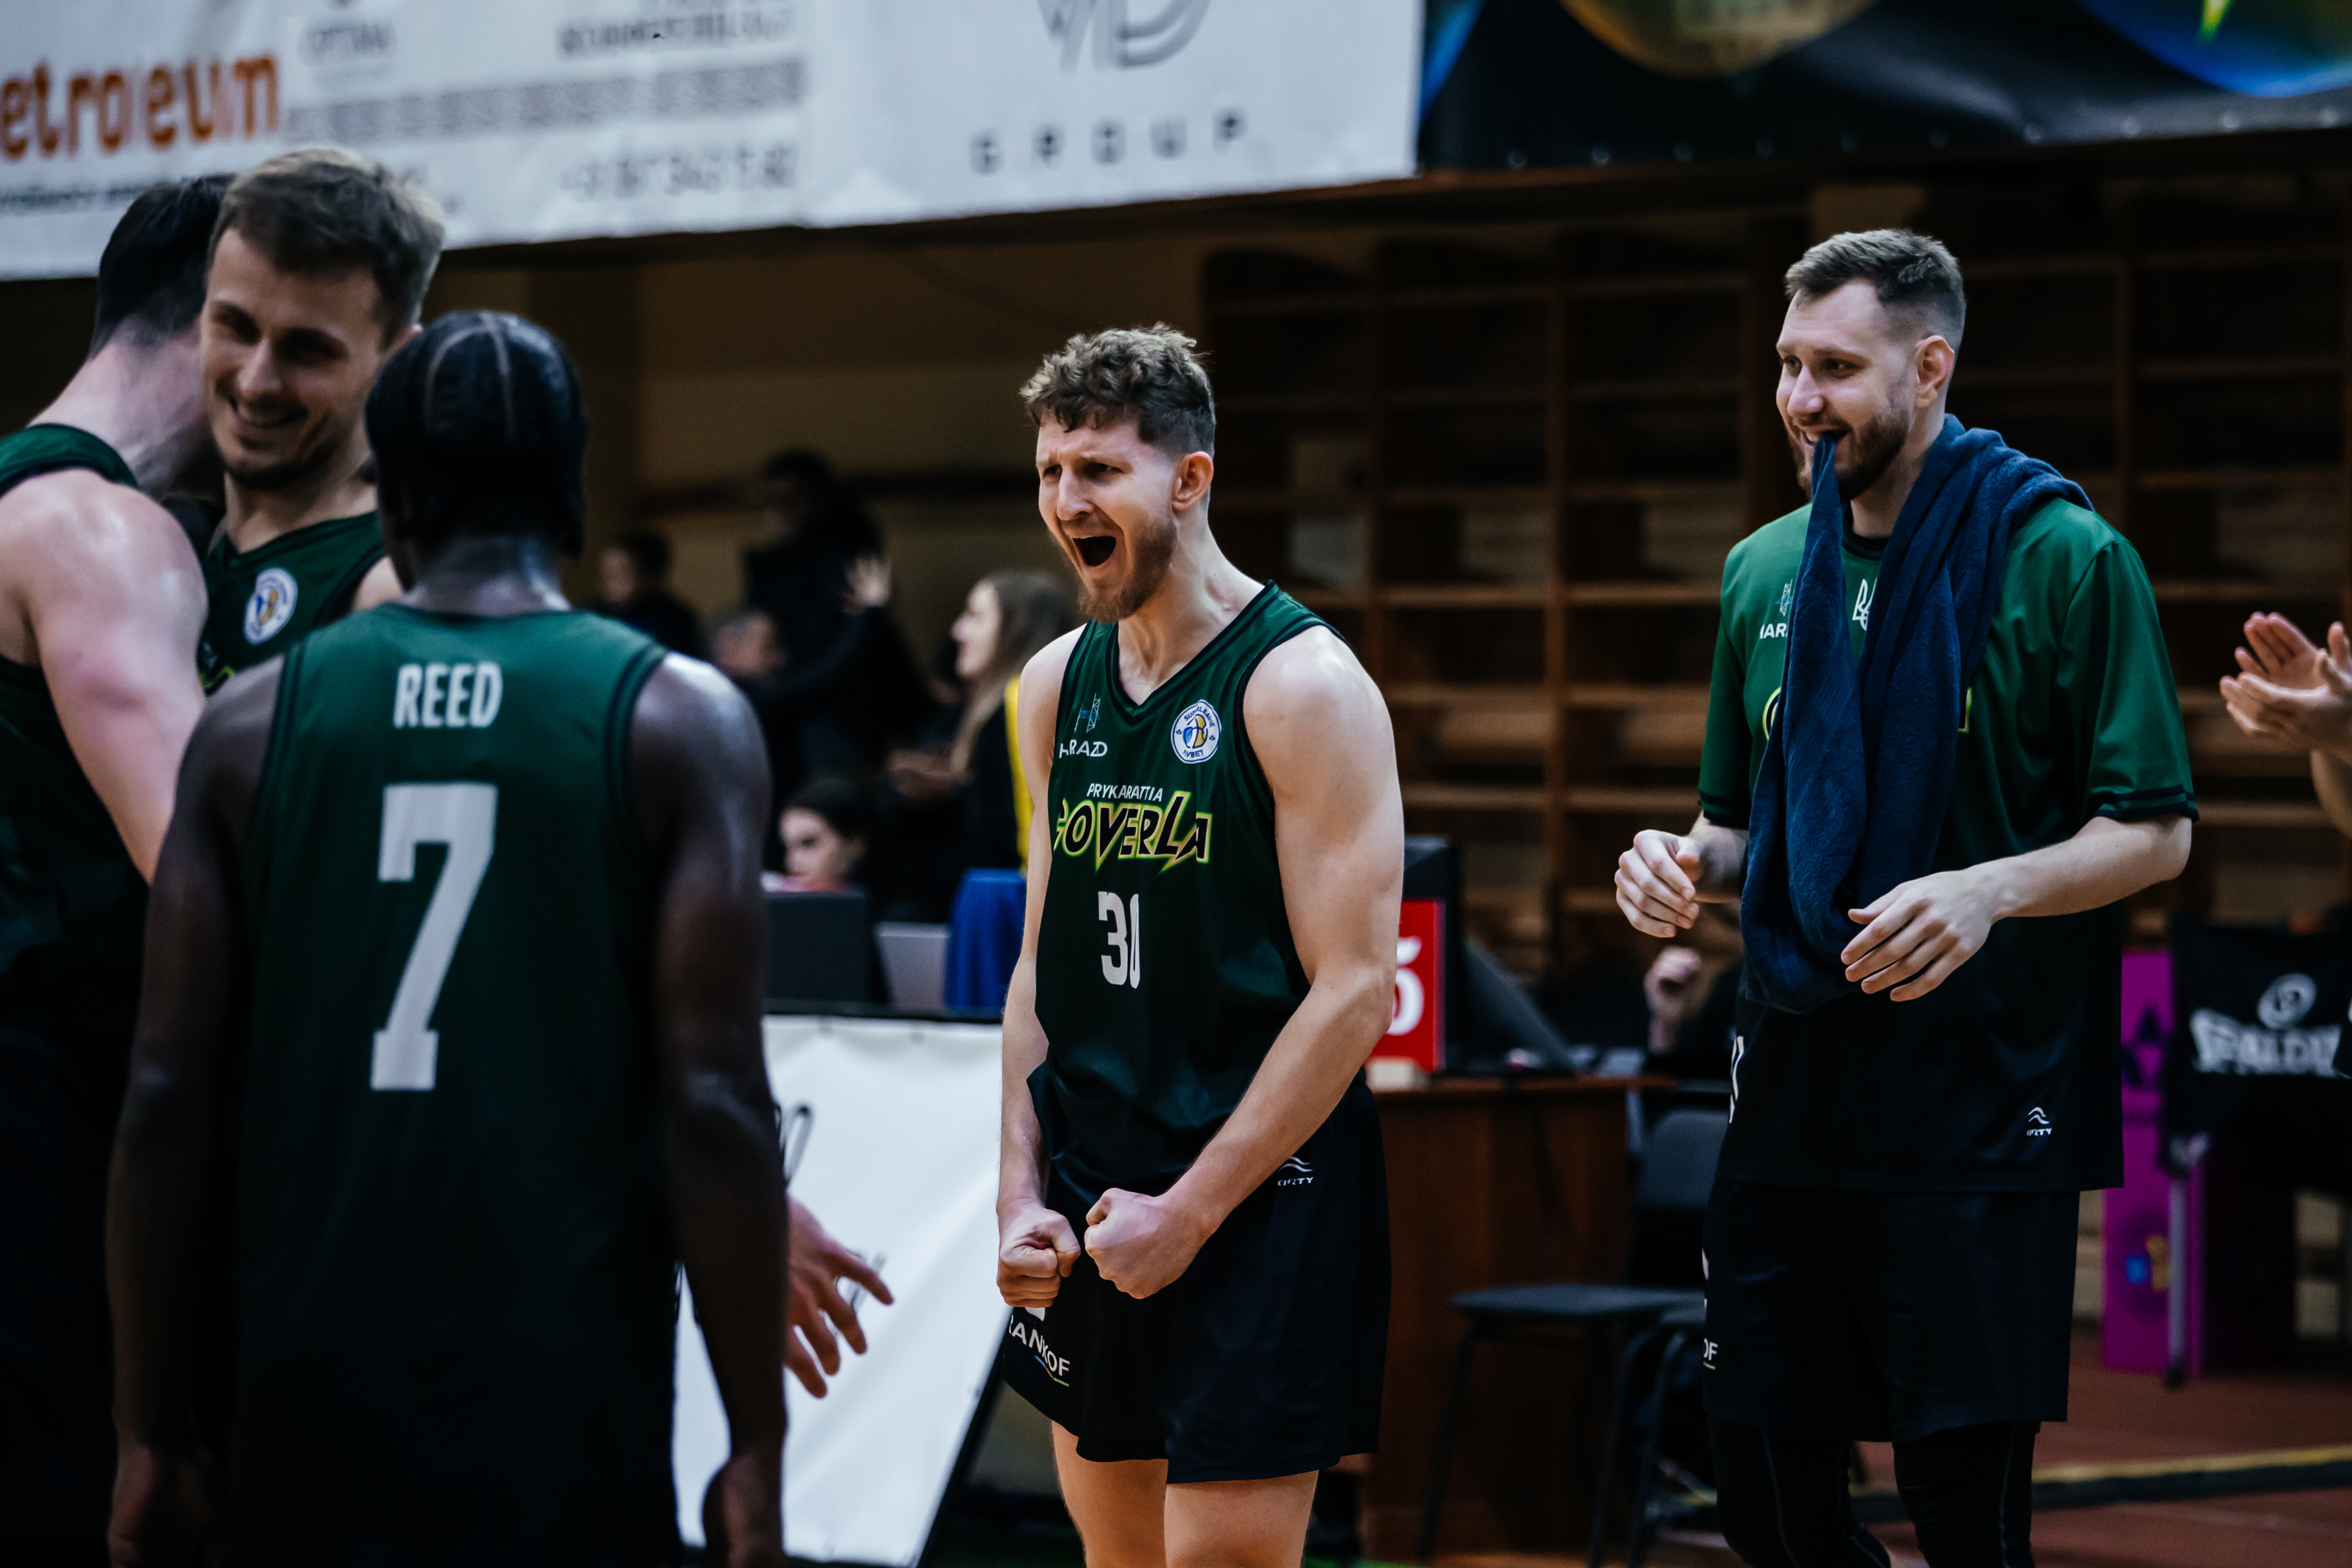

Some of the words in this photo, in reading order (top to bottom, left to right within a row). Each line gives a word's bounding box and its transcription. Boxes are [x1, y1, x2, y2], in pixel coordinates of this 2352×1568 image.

[970, 107, 1248, 175] GROUP
[394, 662, 503, 728] REED
[370, 783, 498, 1091] 7
[1009, 1315, 1070, 1376] ANKOF
